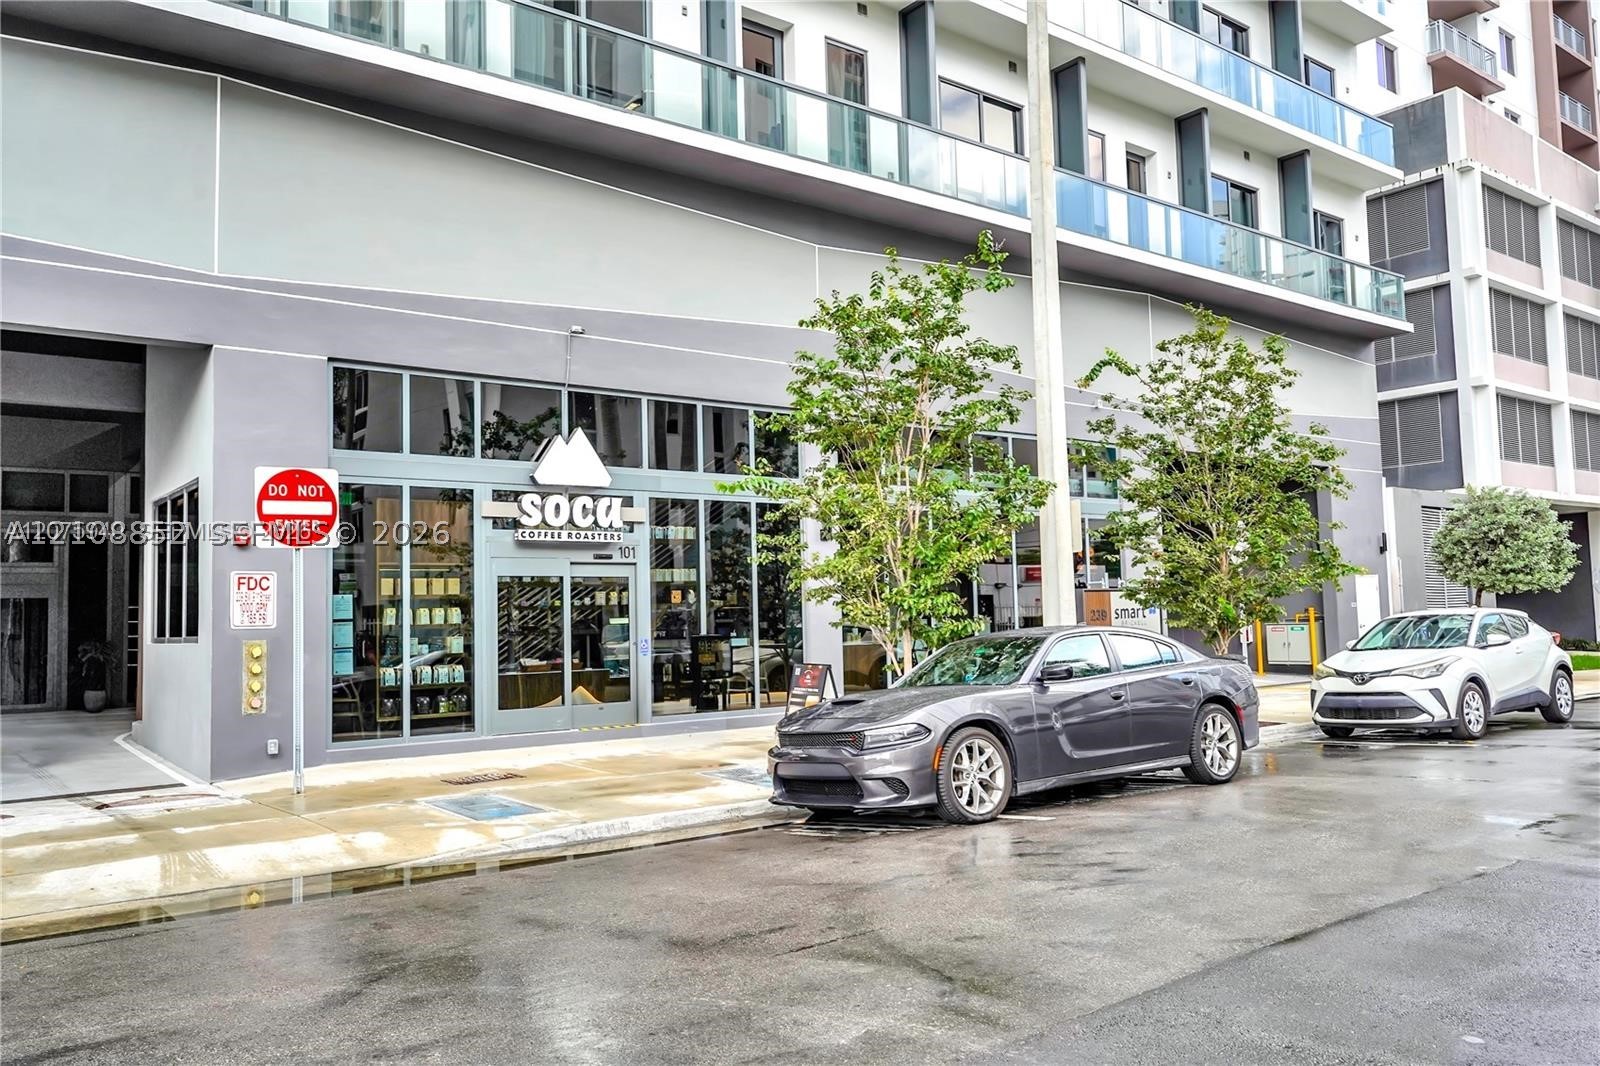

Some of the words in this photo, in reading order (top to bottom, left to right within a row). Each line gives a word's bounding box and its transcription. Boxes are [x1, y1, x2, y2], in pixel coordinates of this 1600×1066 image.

[268, 484, 289, 497] DO
[297, 484, 325, 498] NOT
[274, 519, 321, 532] ENTER
[520, 530, 562, 539] COFFEE
[567, 532, 622, 541] ROASTERS
[618, 546, 636, 559] 101
[237, 576, 270, 591] FDC
[1114, 607, 1147, 620] smart
